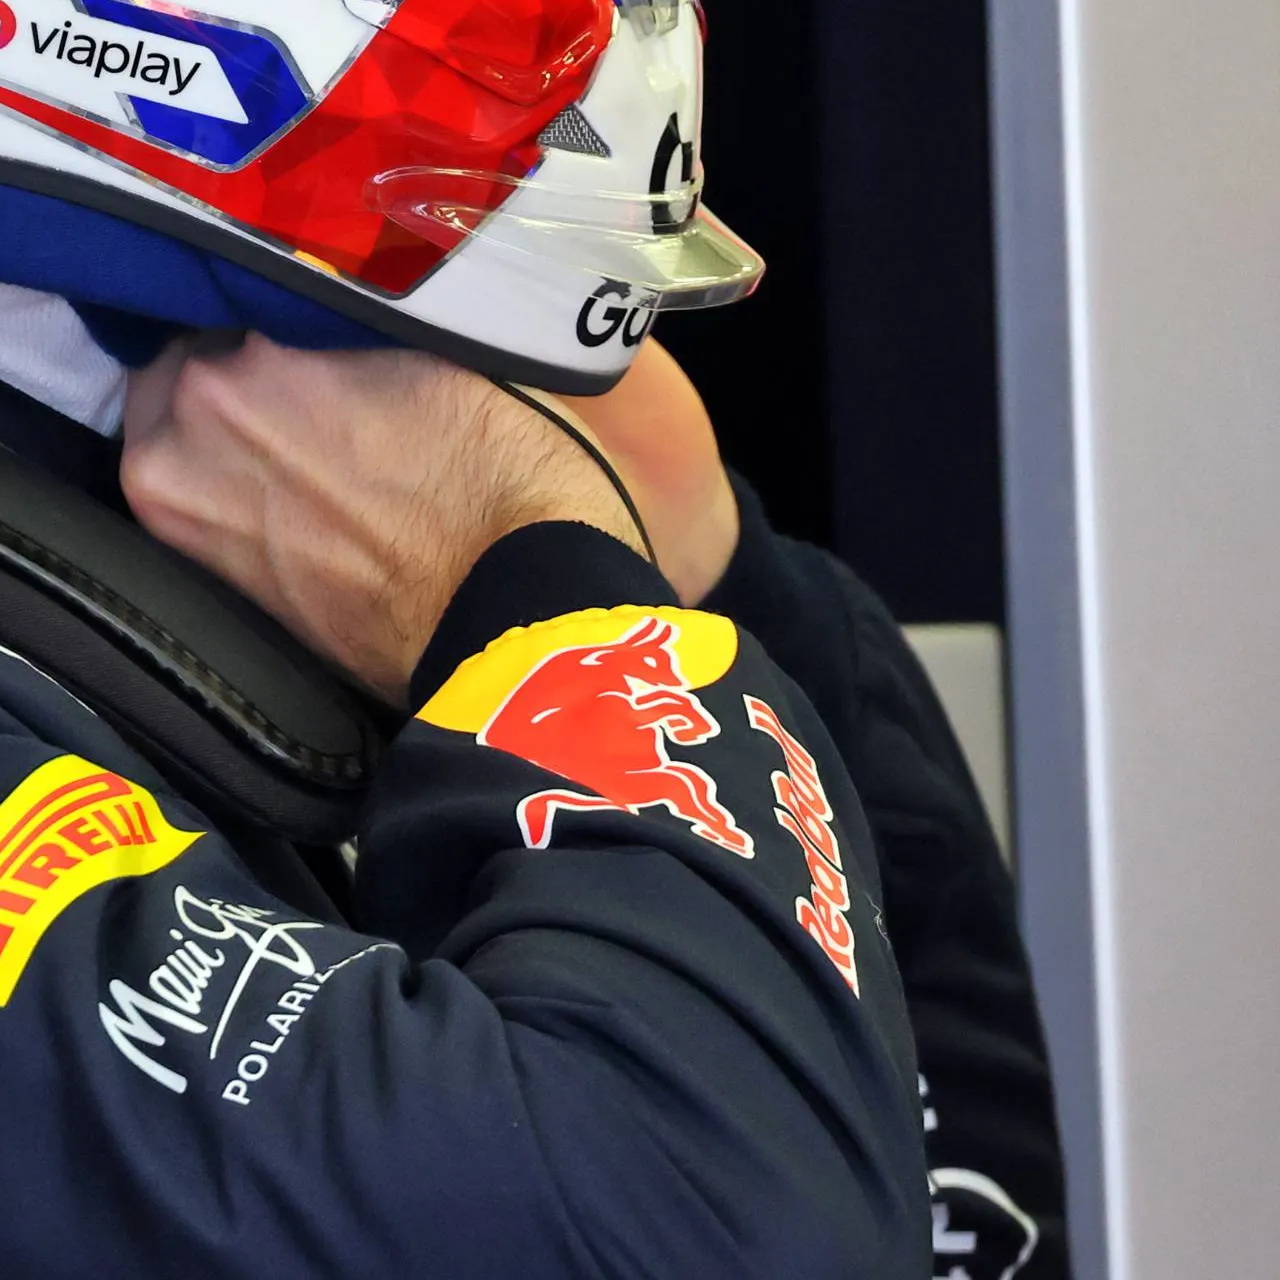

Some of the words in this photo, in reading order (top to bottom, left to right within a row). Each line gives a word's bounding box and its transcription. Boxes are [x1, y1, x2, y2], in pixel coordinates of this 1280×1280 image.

[30, 20, 201, 96] viaplay
[746, 696, 839, 867] Bull
[98, 928, 225, 1094] Maui
